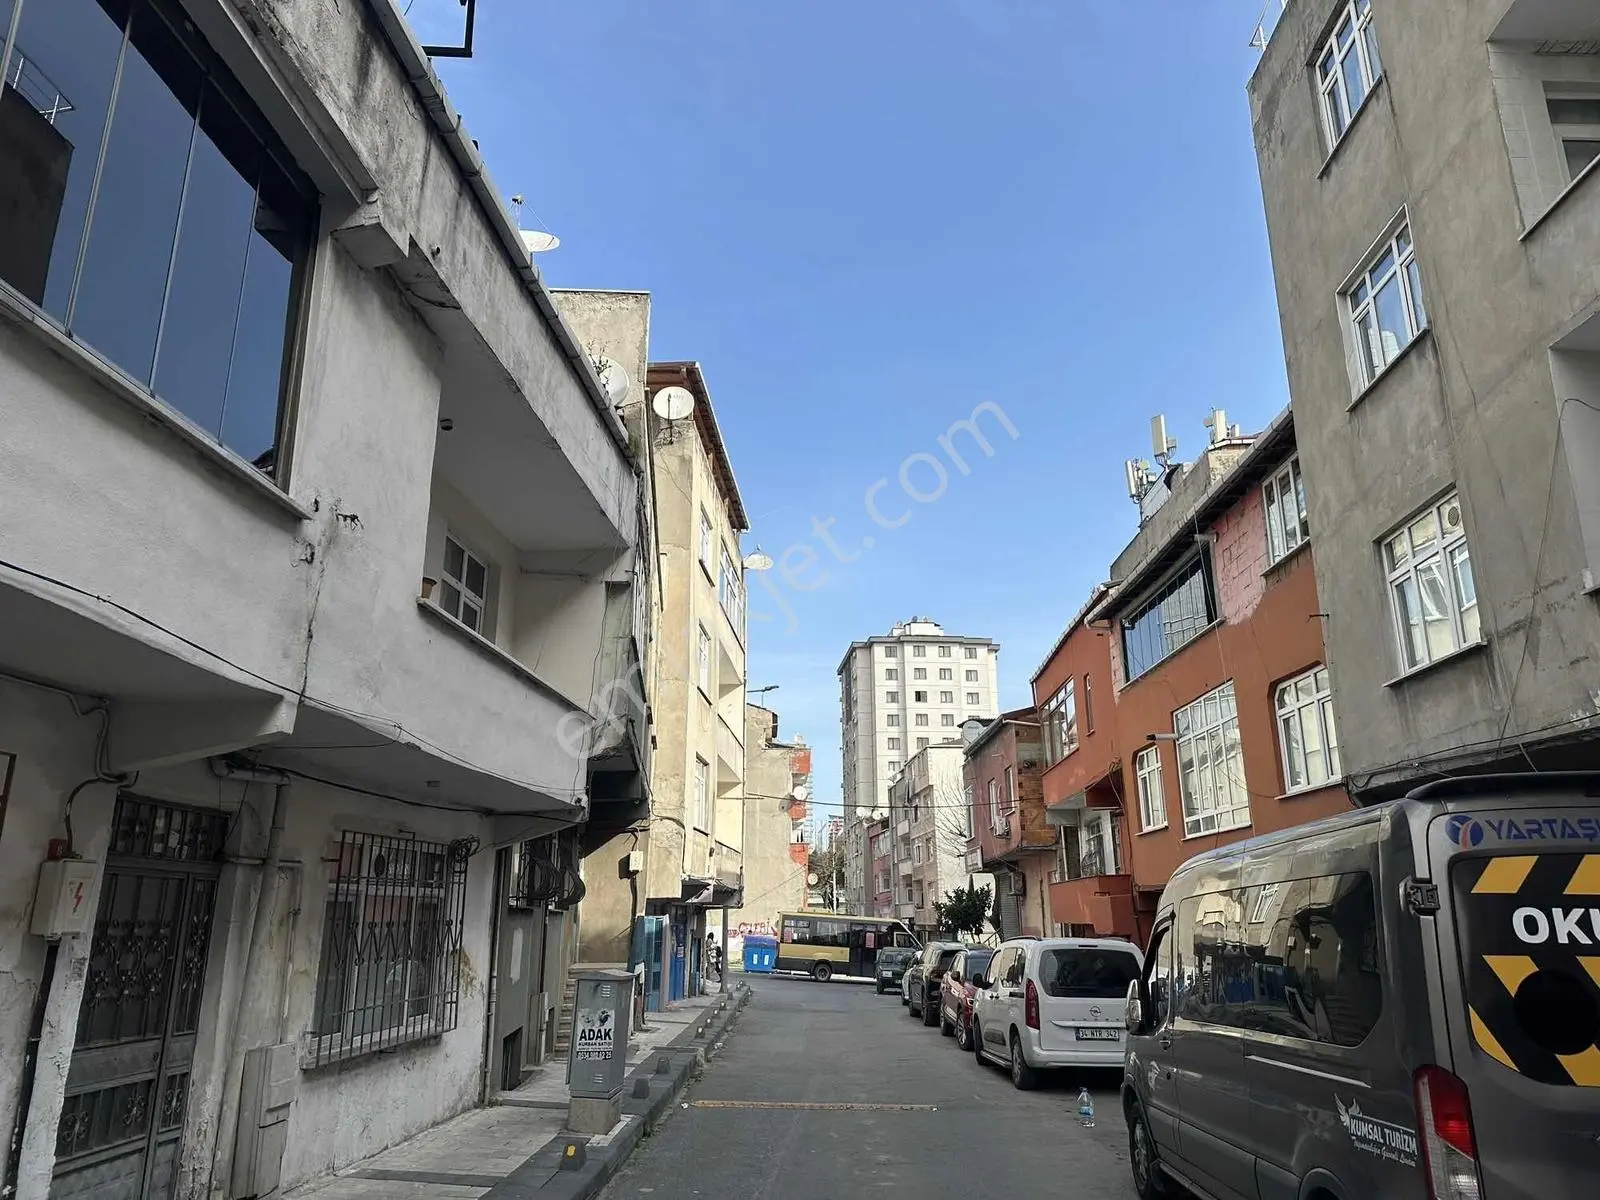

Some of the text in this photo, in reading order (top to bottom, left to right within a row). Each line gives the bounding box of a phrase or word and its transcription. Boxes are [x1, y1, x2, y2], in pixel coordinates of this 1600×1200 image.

[1485, 818, 1600, 842] YARTAŞ
[579, 1028, 612, 1041] ADAK
[1080, 1030, 1088, 1038] 34
[1106, 1030, 1118, 1038] 342
[1350, 1118, 1384, 1143] KUMSAL
[1384, 1128, 1418, 1155] TURİZM
